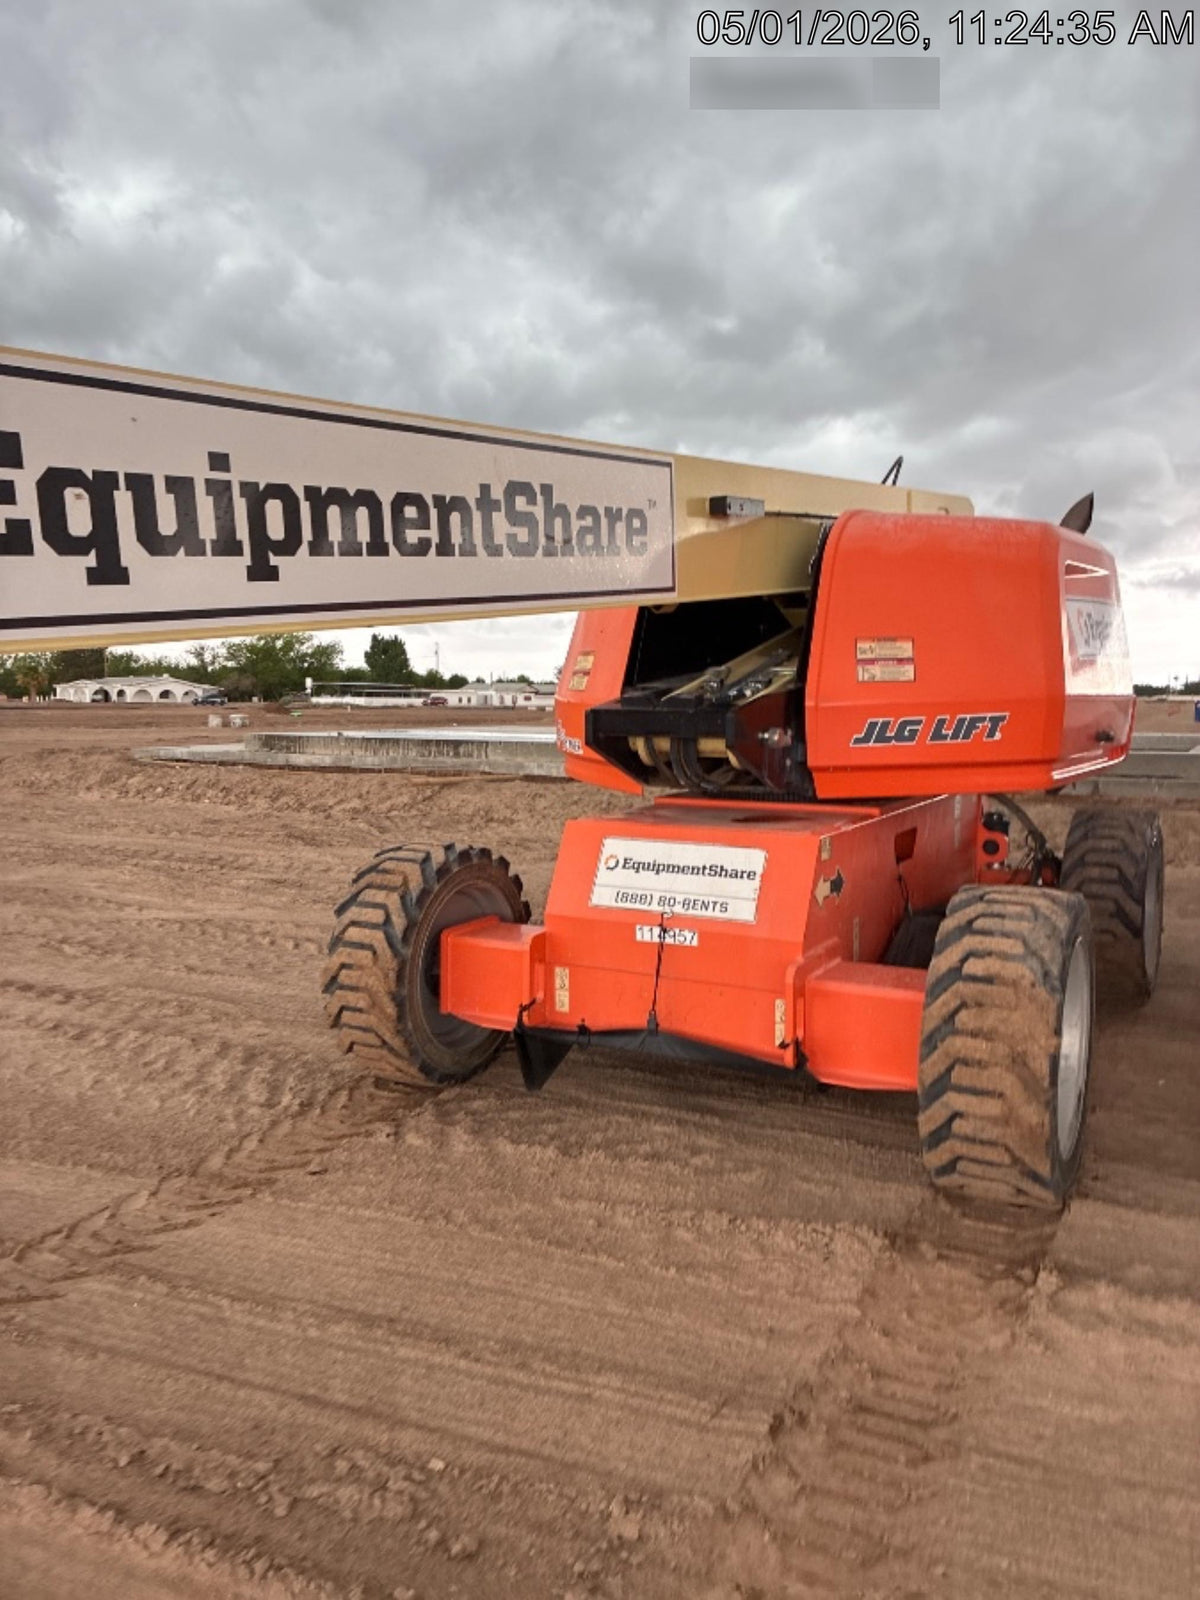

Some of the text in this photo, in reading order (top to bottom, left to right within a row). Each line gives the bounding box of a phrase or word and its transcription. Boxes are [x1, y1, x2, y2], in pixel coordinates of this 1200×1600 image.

[850, 712, 1010, 747] JLG LIFT
[621, 857, 758, 881] EquipmentShare
[614, 890, 654, 906] (888)
